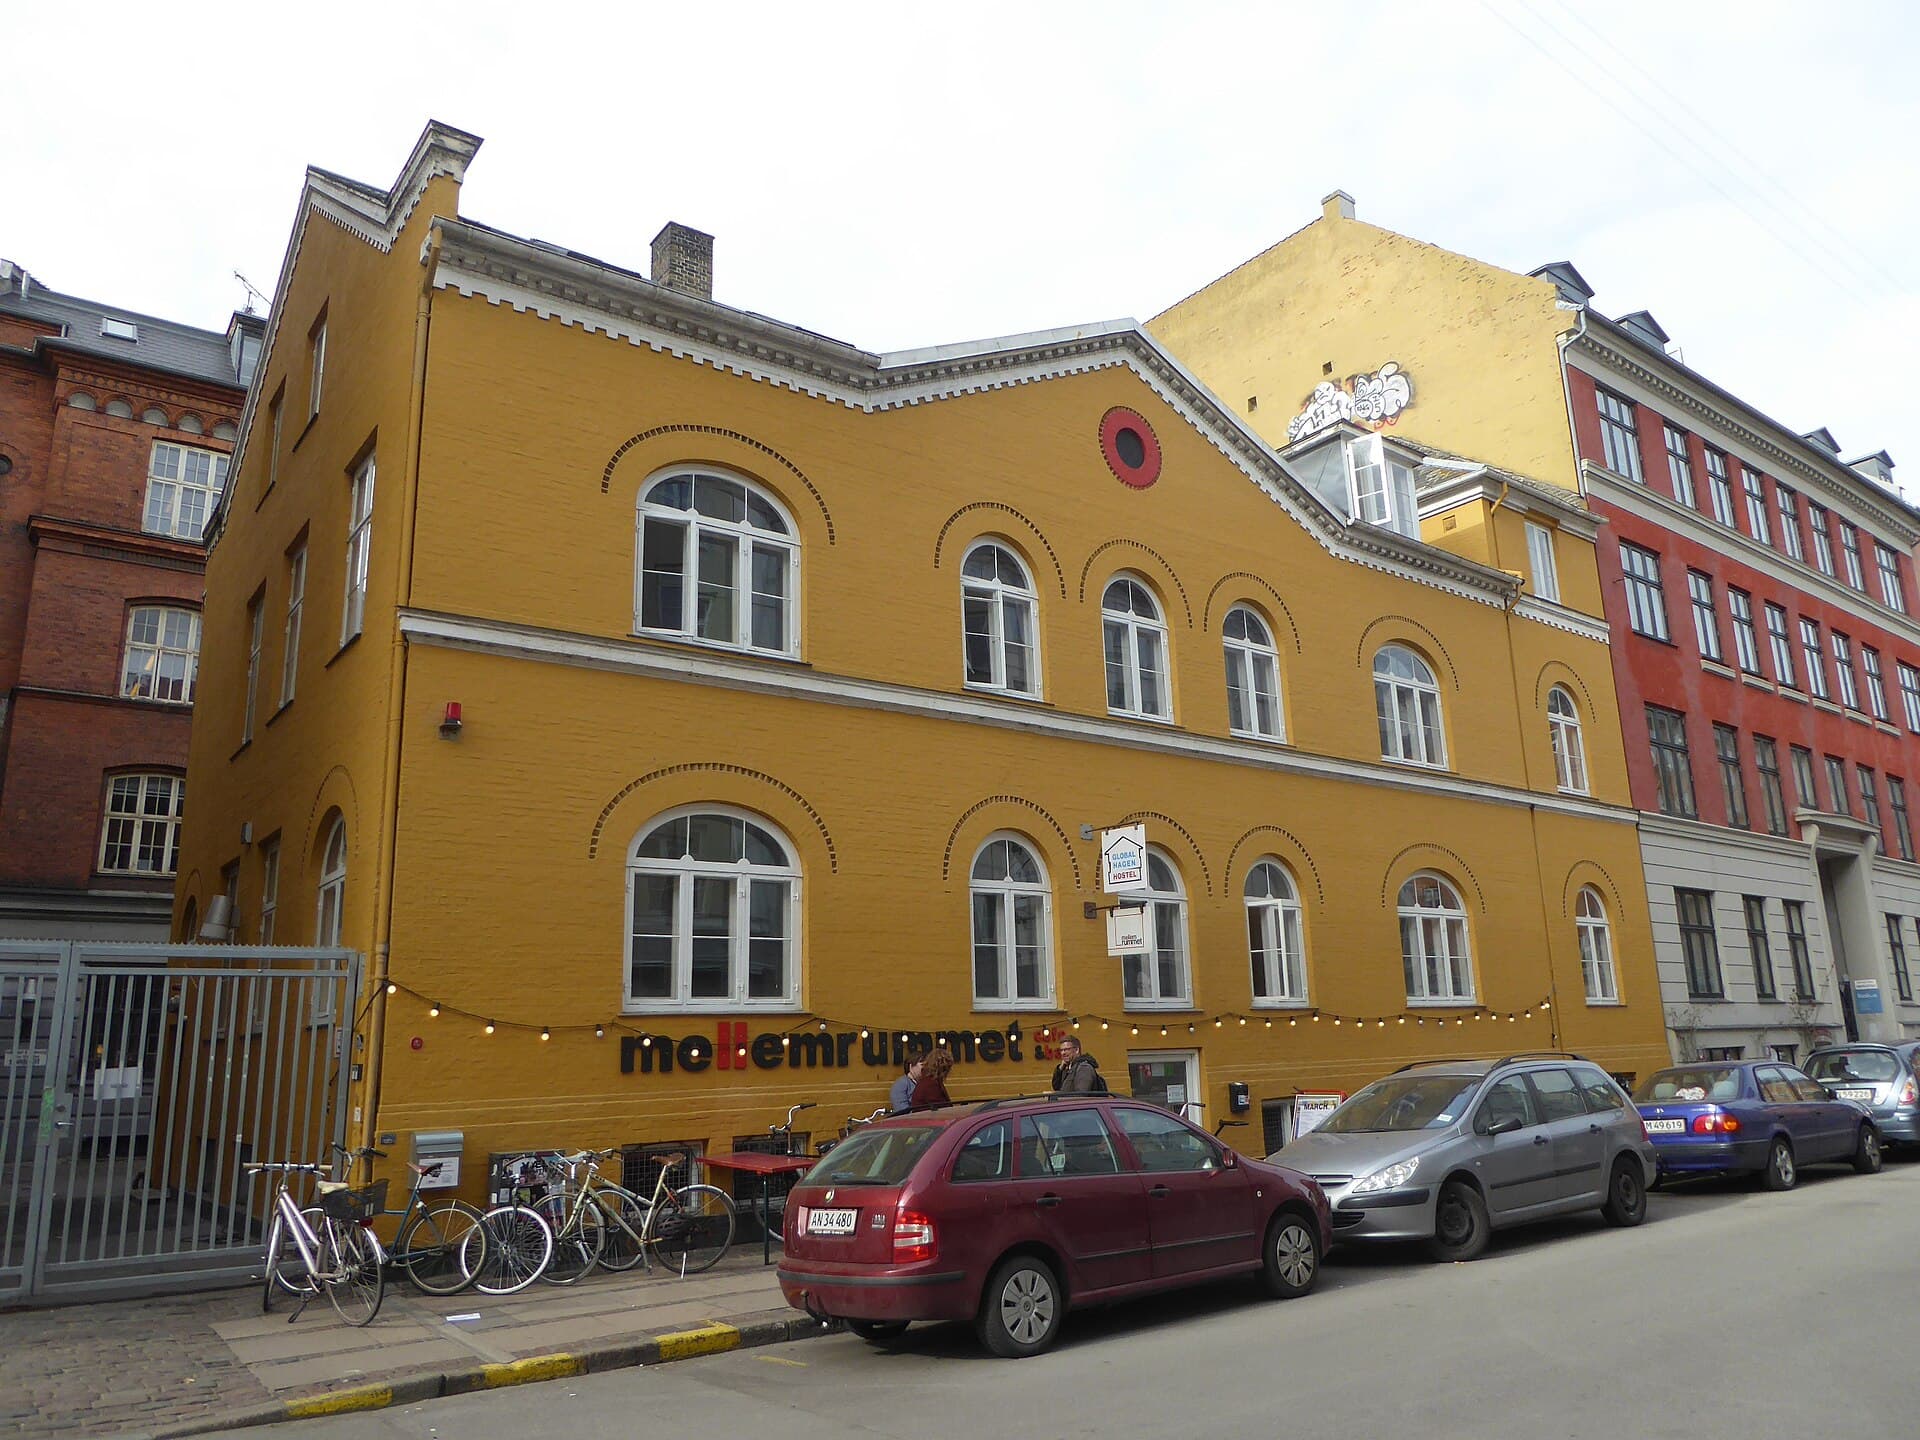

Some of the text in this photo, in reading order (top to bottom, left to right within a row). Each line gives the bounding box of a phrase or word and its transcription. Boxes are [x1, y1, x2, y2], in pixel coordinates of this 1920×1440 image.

[1112, 851, 1136, 860] GLOBAL
[1112, 860, 1136, 869] HAGEN
[1113, 871, 1137, 880] HOSTEL
[621, 1019, 1023, 1073] mellemrummet
[1654, 1121, 1664, 1129] 49
[1665, 1121, 1682, 1129] 619
[811, 1212, 852, 1228] AN 34 480
